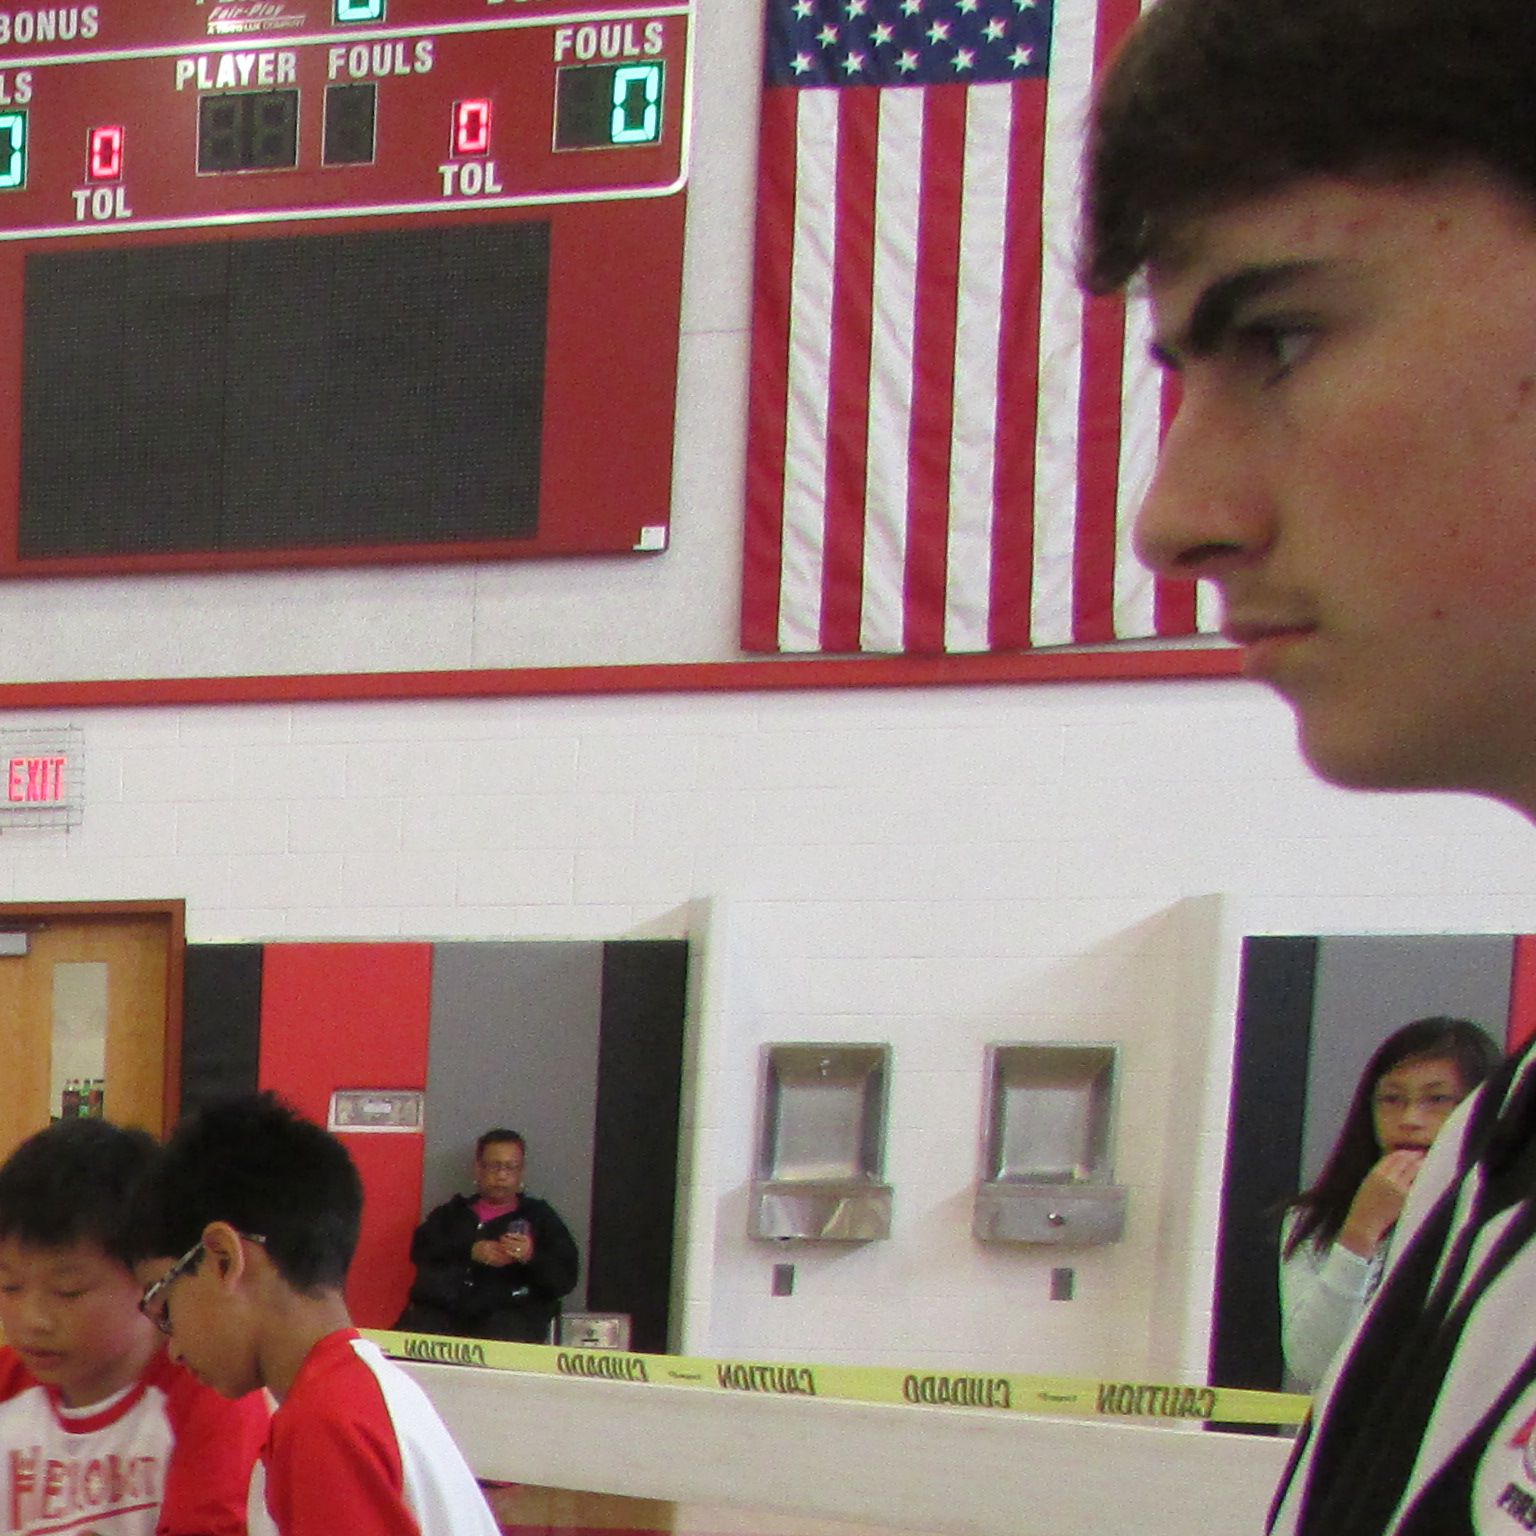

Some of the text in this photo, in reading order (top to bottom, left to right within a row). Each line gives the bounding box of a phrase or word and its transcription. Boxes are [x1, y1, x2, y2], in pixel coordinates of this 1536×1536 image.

[328, 40, 435, 80] FOULS
[554, 22, 663, 61] FOULS
[176, 51, 296, 91] PLAYER
[612, 66, 658, 144] 0
[457, 101, 488, 151] 0
[91, 128, 122, 178] 0
[438, 162, 502, 196] TOL
[72, 188, 133, 220] TOL
[8, 757, 67, 803] EXIT
